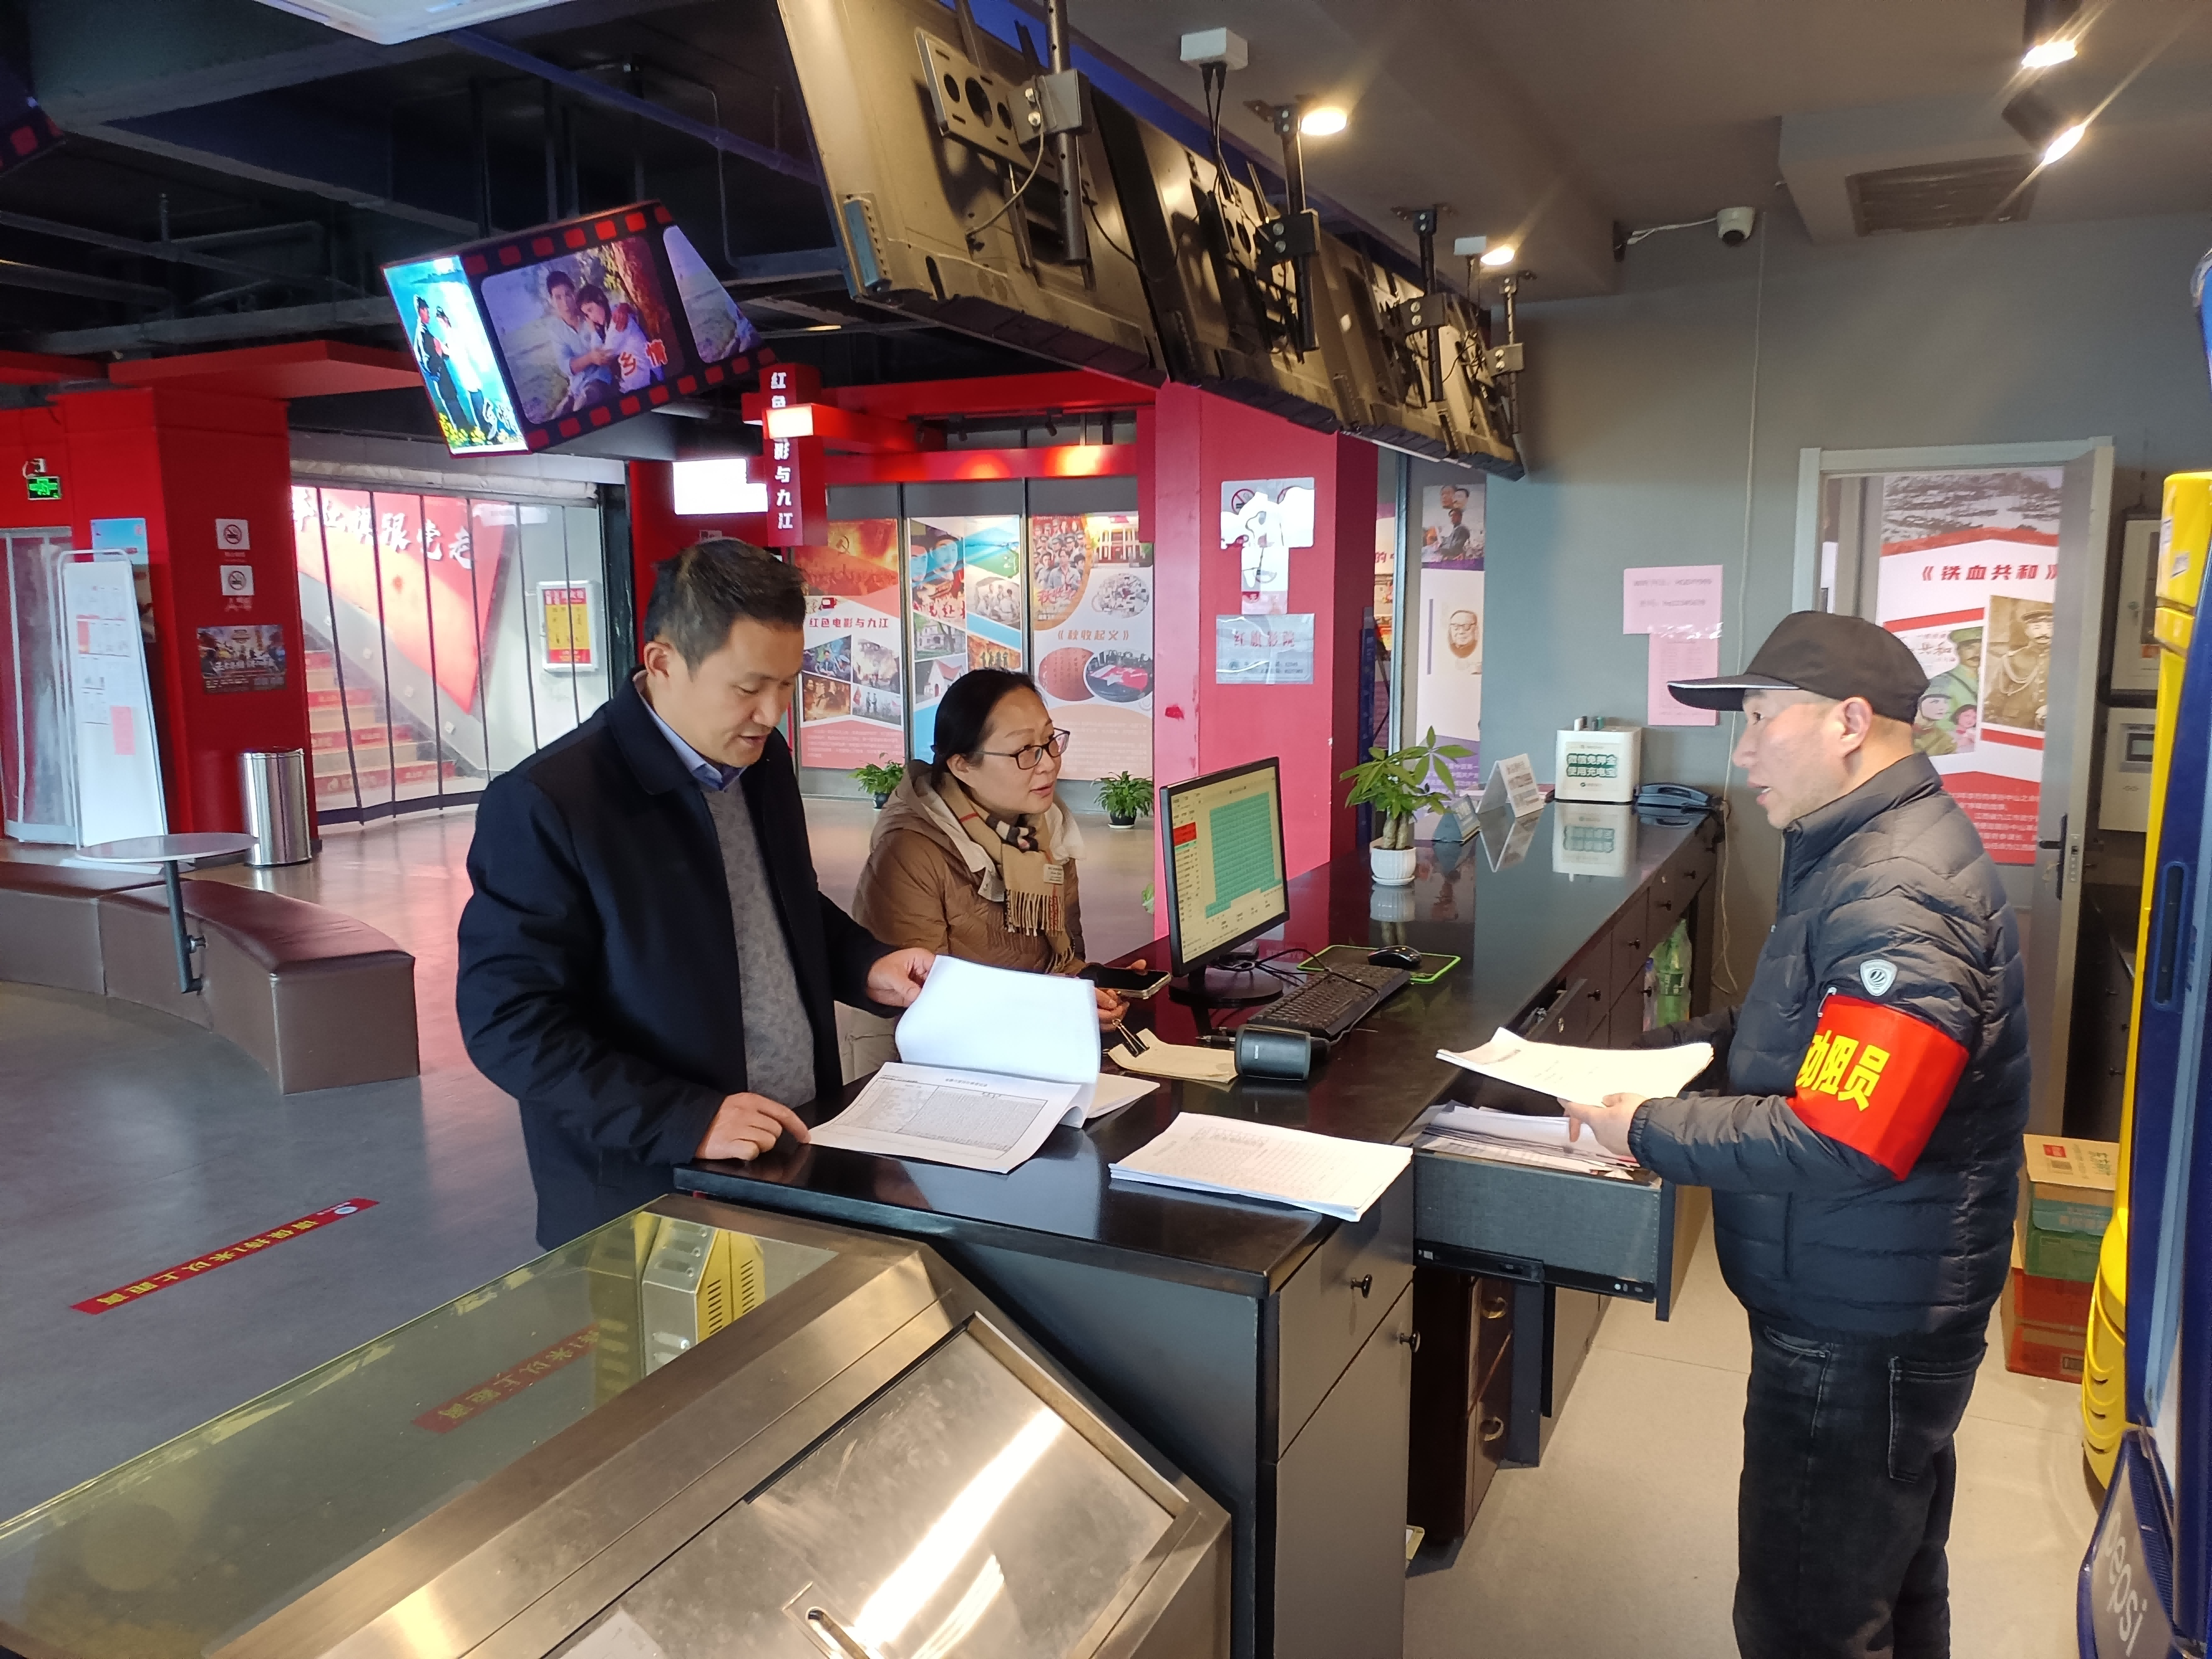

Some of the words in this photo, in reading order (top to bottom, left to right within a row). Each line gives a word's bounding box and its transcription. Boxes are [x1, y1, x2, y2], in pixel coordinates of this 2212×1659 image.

[771, 372, 794, 530] 红色影与九江
[1922, 564, 2059, 581] 《铁血共和》
[809, 617, 889, 628] 红色电影与九江
[1057, 629, 1129, 641] 《秋收起义》
